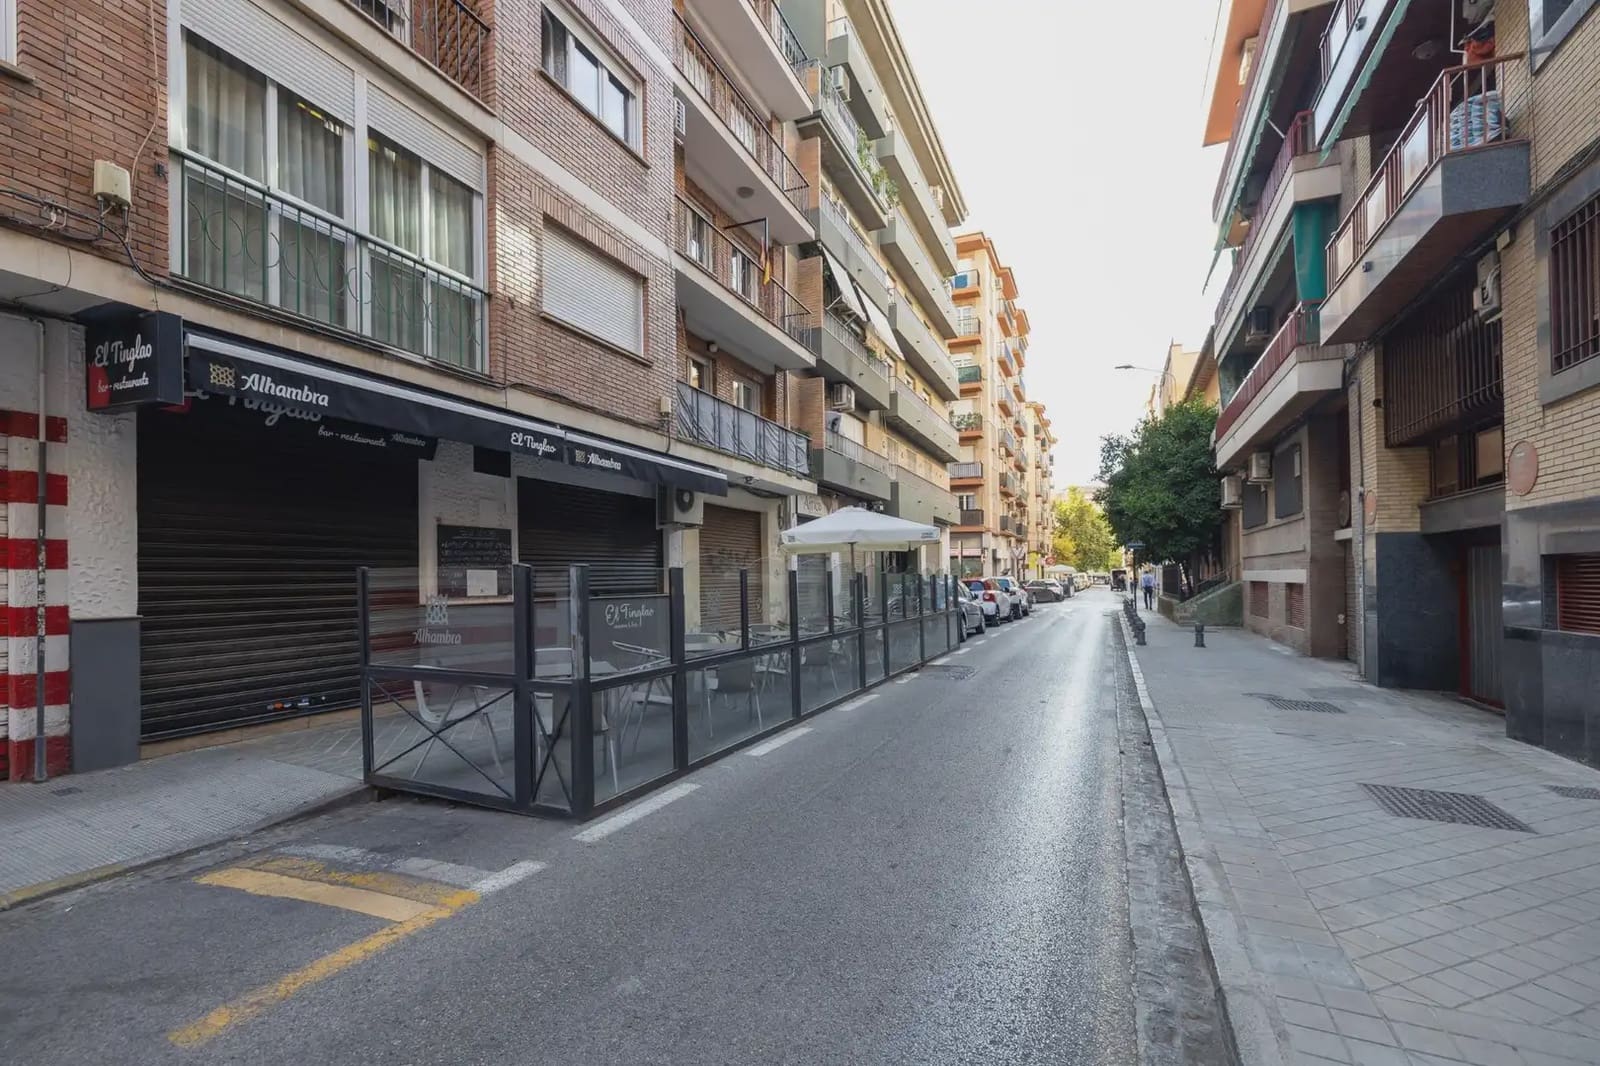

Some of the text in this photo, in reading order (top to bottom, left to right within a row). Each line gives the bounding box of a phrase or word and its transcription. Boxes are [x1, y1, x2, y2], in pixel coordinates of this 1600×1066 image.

[94, 333, 152, 373] El Tinglao
[241, 373, 329, 407] Alhambra
[510, 432, 524, 446] El
[587, 452, 622, 471] Alhambra
[412, 627, 462, 645] Alhambra
